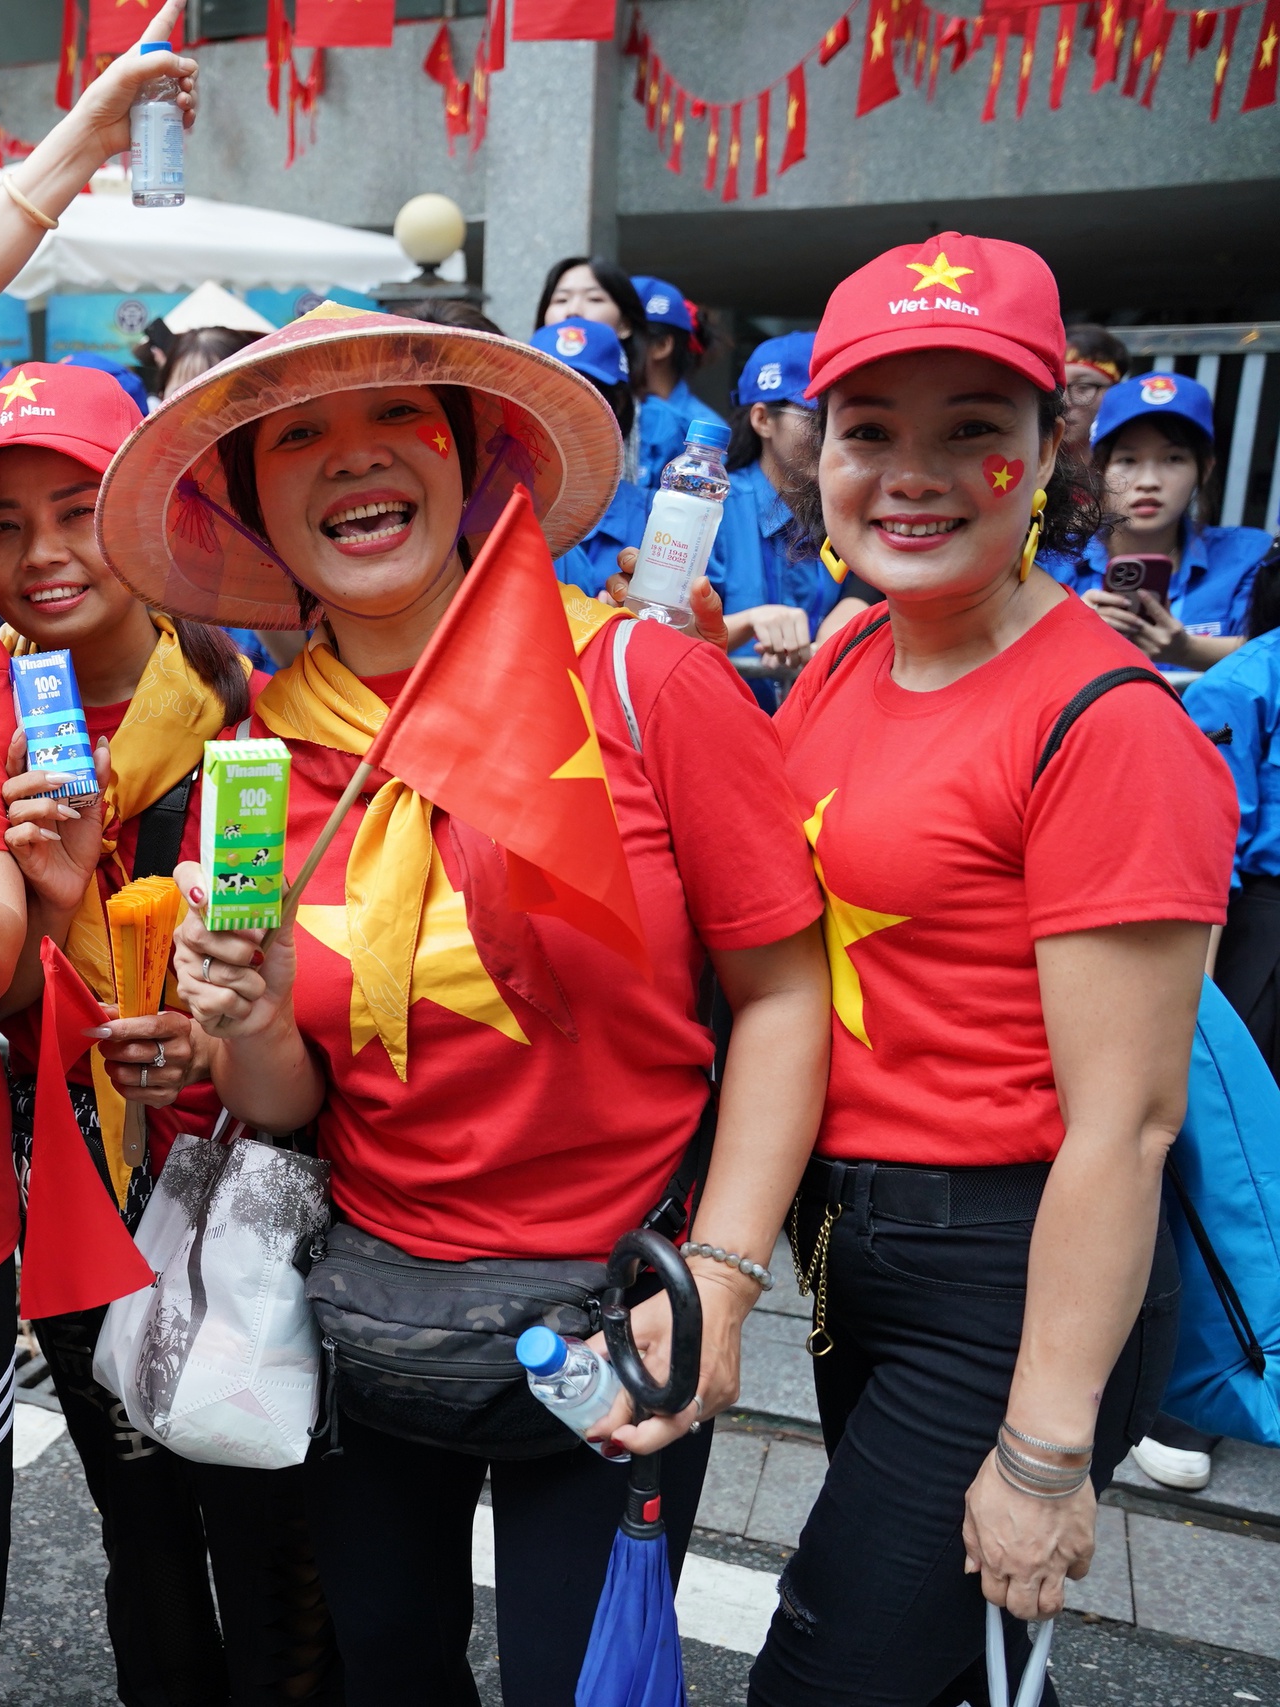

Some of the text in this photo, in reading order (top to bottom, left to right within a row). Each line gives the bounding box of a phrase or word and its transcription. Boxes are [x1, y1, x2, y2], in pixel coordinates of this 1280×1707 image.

[888, 297, 979, 316] Viet Nam
[20, 404, 55, 416] Nam
[654, 531, 671, 545] 80
[667, 555, 687, 564] 2025
[668, 549, 688, 558] 1945
[18, 653, 66, 670] Vinamilk
[34, 675, 62, 693] 100%
[225, 762, 283, 778] Vinamilk
